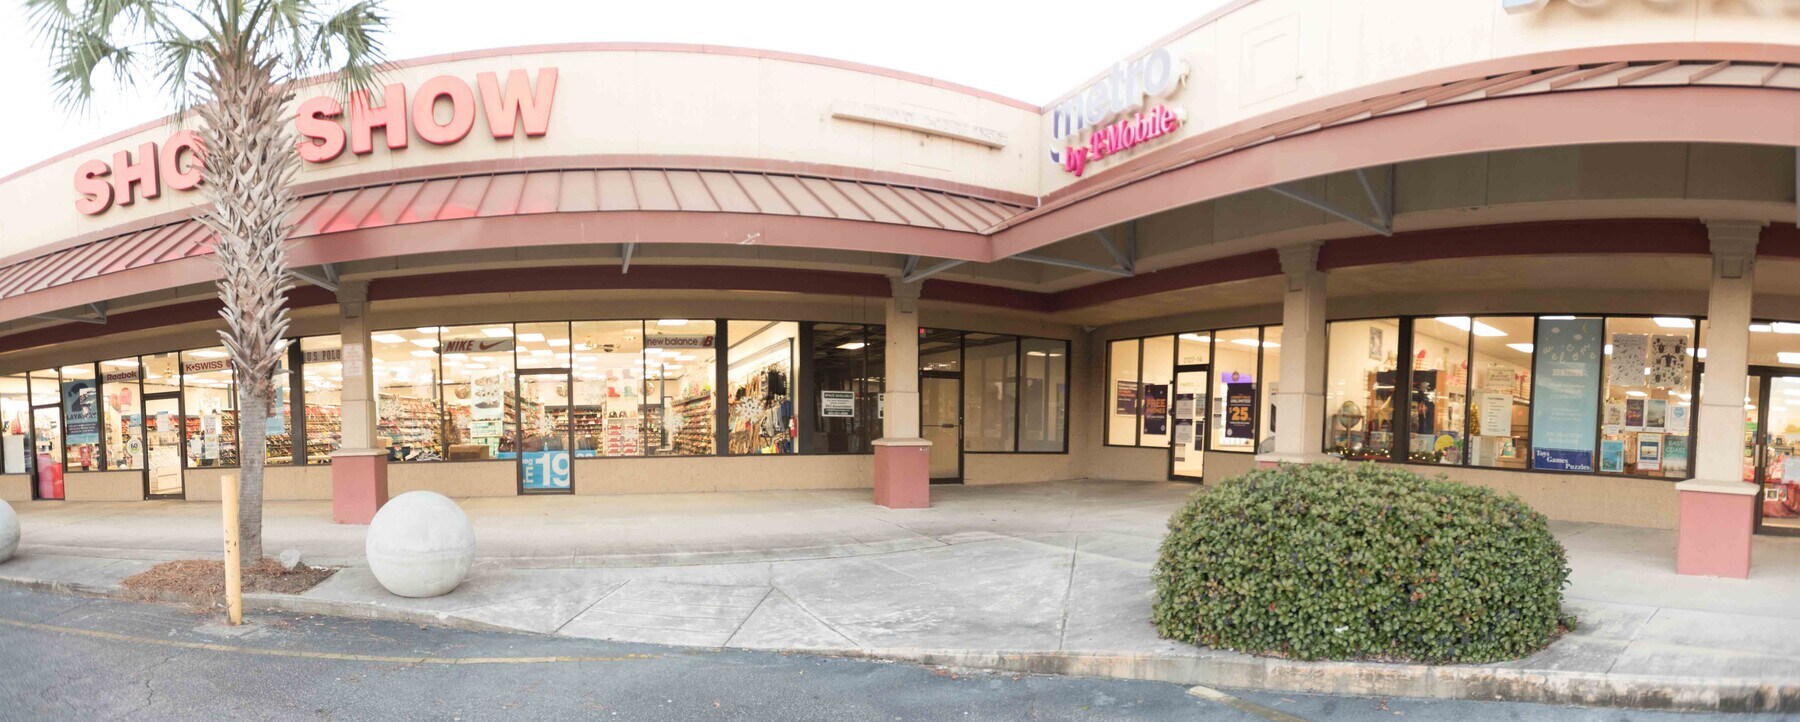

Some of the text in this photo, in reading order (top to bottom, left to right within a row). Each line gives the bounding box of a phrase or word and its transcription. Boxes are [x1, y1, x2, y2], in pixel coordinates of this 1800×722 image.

[73, 67, 559, 217] SHO SHOW
[1065, 146, 1088, 177] by
[446, 340, 475, 352] NIKE
[647, 336, 698, 346] new balance
[306, 349, 341, 362] U.S. POLO
[106, 371, 137, 381] Reebok
[1536, 449, 1550, 458] Toys
[1546, 456, 1569, 464] Games
[535, 452, 570, 487] 19
[1565, 463, 1590, 471] Puzzles
